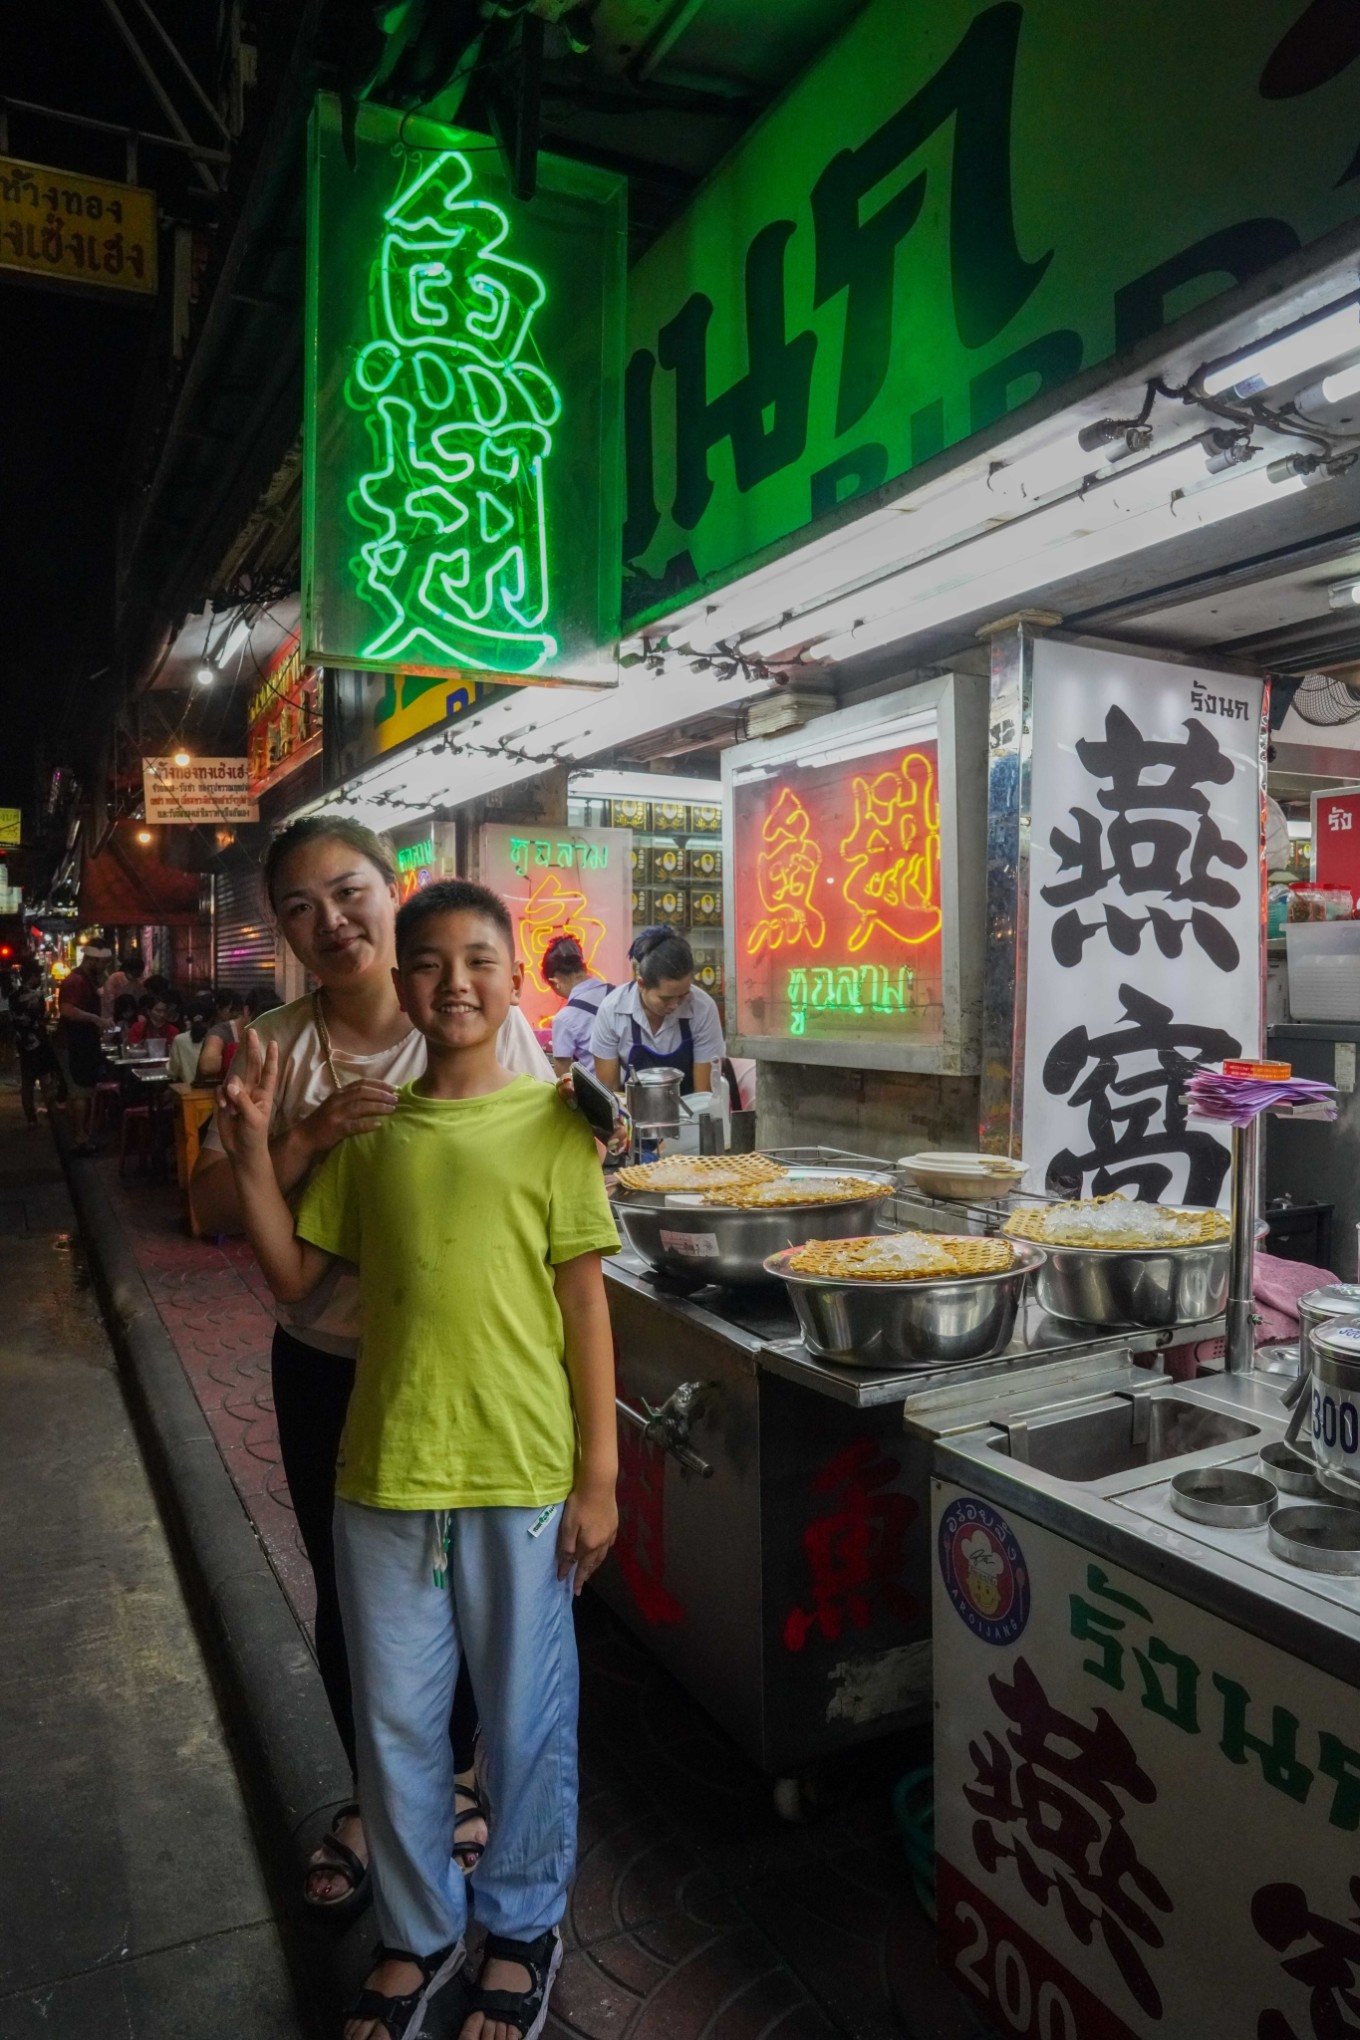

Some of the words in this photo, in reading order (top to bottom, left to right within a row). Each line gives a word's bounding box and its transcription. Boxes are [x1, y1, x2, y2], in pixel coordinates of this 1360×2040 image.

[1190, 680, 1250, 721] รังนก
[1328, 806, 1353, 831] รัง
[951, 1589, 1019, 1640] AROIJANG
